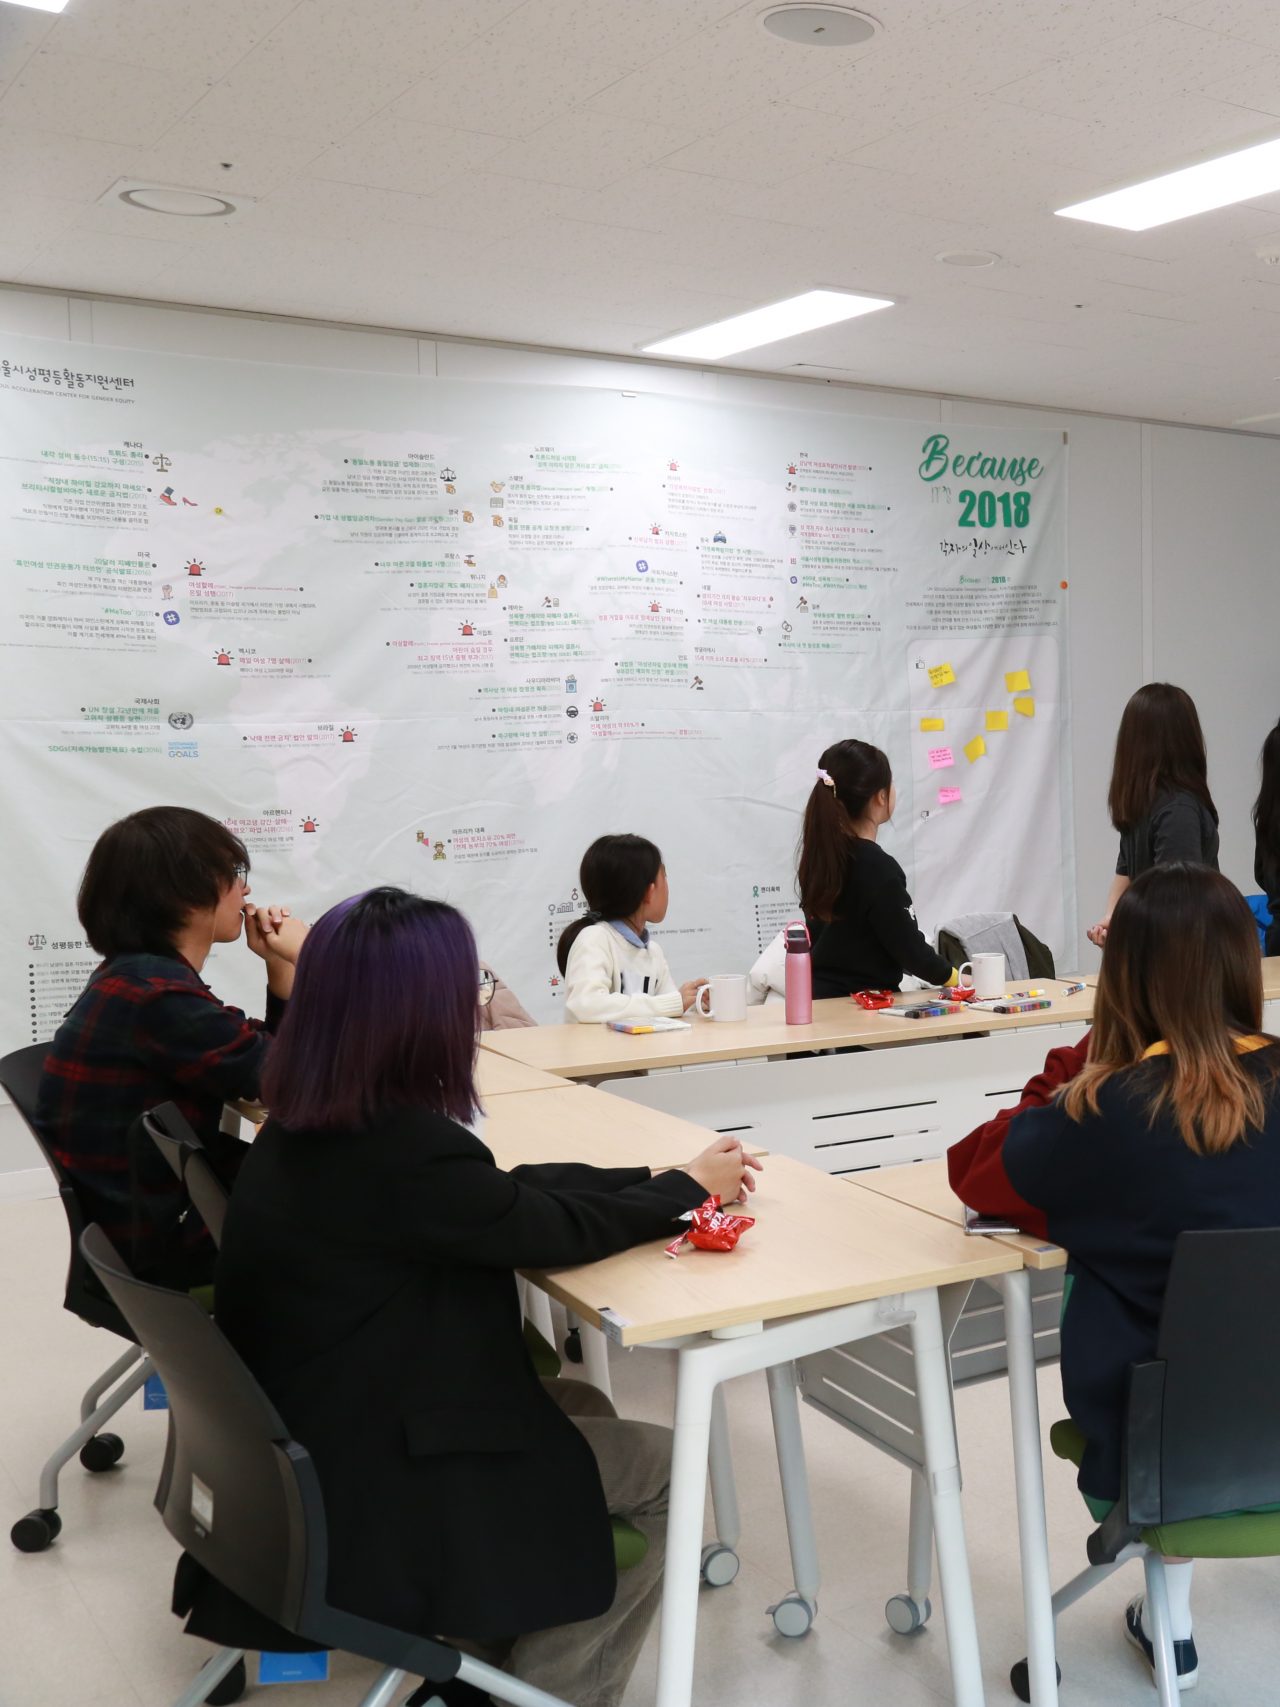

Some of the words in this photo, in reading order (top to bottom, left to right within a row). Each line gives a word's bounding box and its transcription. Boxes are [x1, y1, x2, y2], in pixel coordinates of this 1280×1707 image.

[0, 360, 135, 391] 울시성평등활동지원센터
[918, 434, 1045, 487] Because
[958, 490, 1032, 528] 2018
